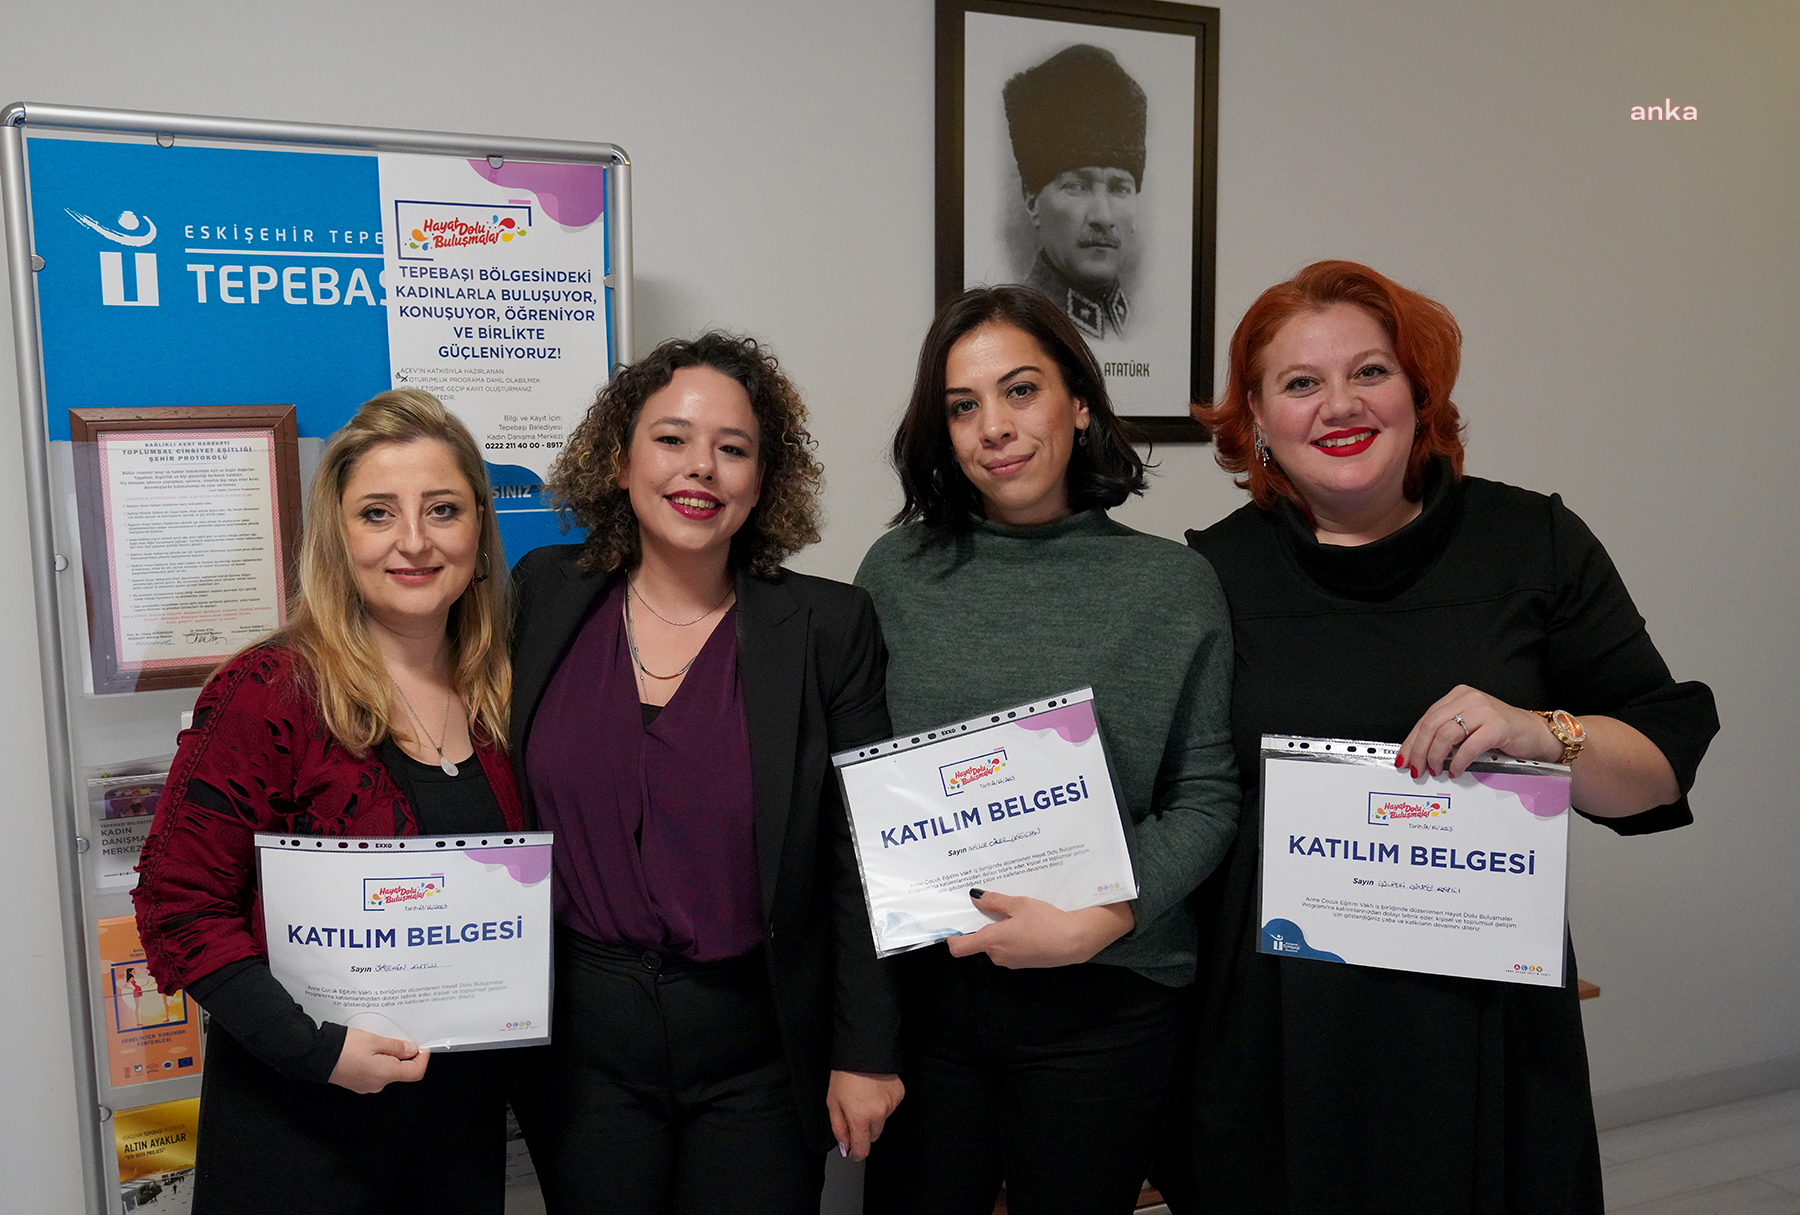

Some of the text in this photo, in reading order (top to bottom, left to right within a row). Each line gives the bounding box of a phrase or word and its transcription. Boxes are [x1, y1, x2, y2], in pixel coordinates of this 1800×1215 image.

[185, 224, 314, 244] ESKİŞEHİR
[423, 217, 486, 236] Hayat Dolu
[432, 229, 504, 249] Buluşmalar
[399, 266, 591, 283] TEPEBAŞI BÖLGESİNDEKİ
[396, 286, 597, 305] KADINLARLA BULUŞUYOR,
[400, 306, 595, 322] KONUŞUYOR, ÖĞRENİYOR
[453, 325, 545, 340] VE BİRLİKTE
[438, 344, 561, 360] GÜÇLENİYORUZ!
[1104, 360, 1150, 377] ATATÜRK
[508, 433, 536, 441] Danışma
[122, 448, 173, 456] TOPLUMSAL
[149, 455, 175, 463] ŞEHİR
[880, 806, 982, 849] KATILIM
[988, 775, 1089, 822] BELGESİ
[101, 827, 132, 837] KADIN
[102, 835, 146, 846] DANIŞMA
[948, 847, 967, 857] Sayın
[1289, 834, 1536, 876] KATILIM BELGESİ
[1353, 877, 1374, 886] Sayın
[287, 915, 523, 949] KATILIM BELGESİ
[350, 965, 372, 974] Sayın
[124, 1140, 148, 1154] ALTIN
[150, 1132, 187, 1148] AYAKLAR
